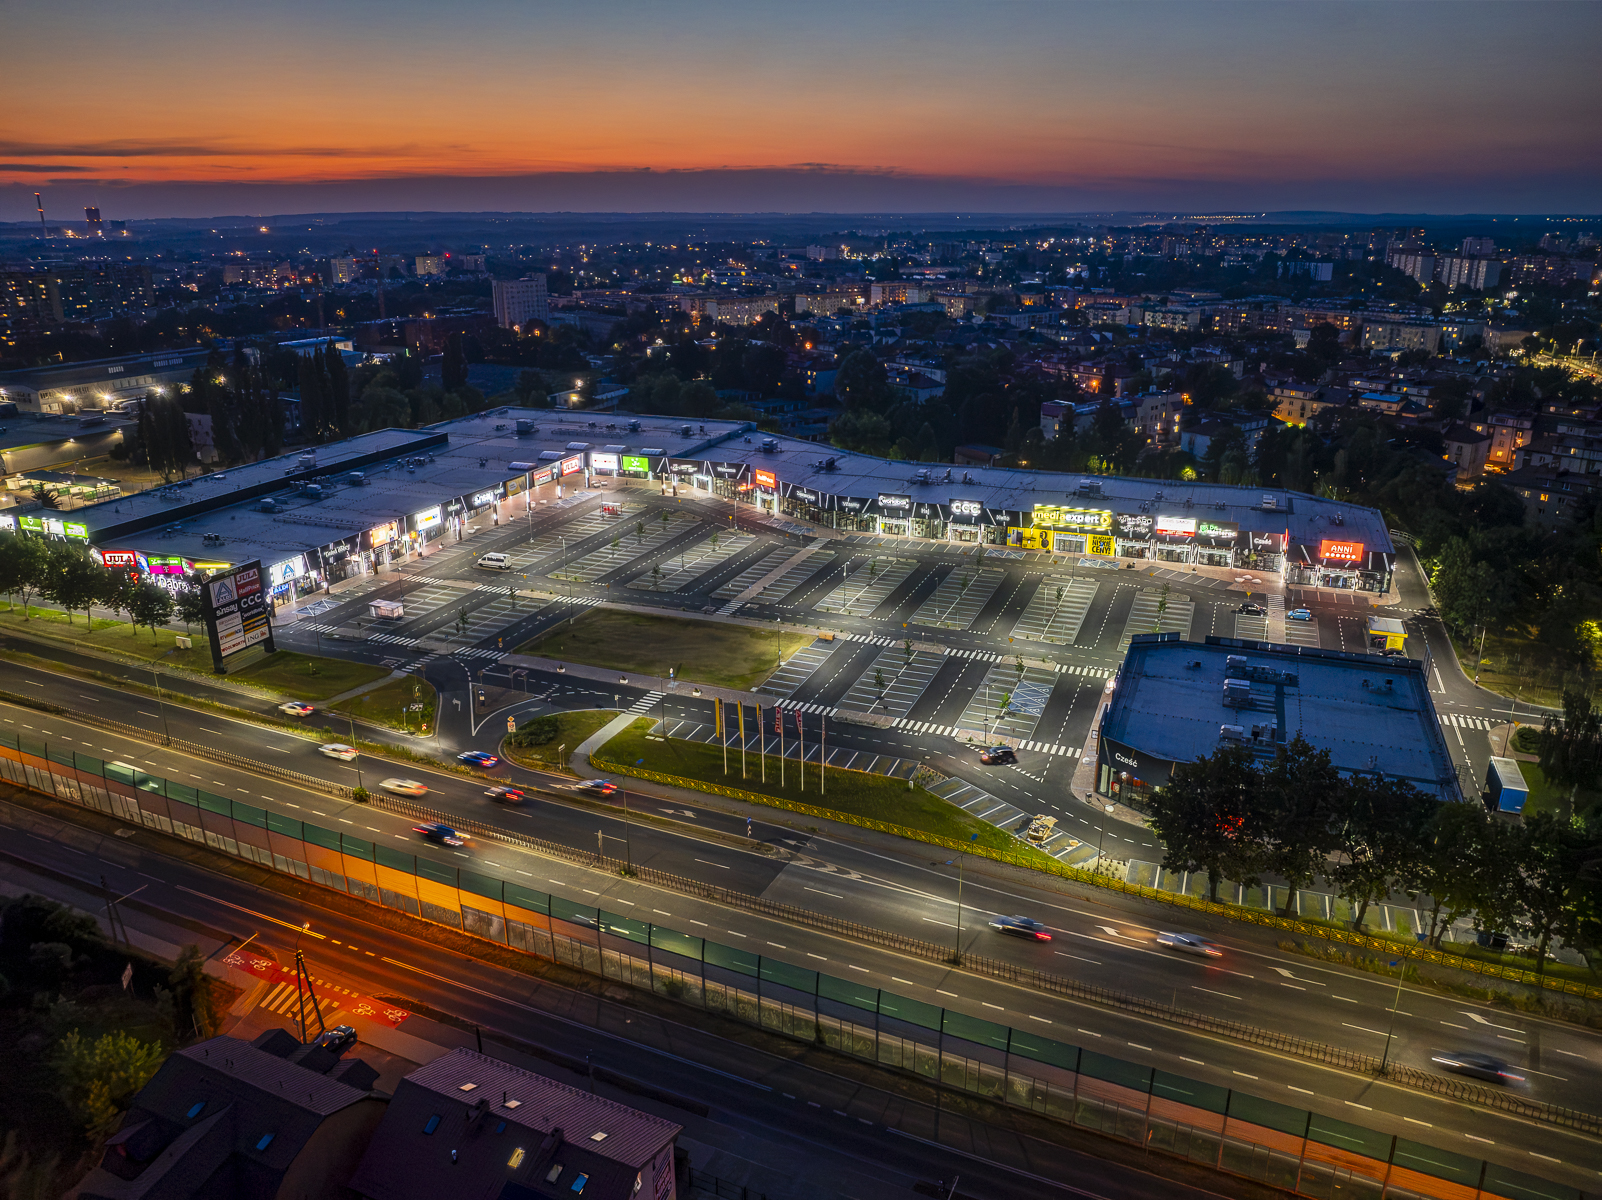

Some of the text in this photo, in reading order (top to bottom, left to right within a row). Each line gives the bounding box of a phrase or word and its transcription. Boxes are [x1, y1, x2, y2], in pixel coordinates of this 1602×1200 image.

[564, 461, 578, 472] JULA
[951, 501, 981, 516] CCC
[106, 555, 134, 563] JULA
[238, 570, 258, 583] JULA
[273, 583, 289, 594] ALDI
[218, 594, 232, 604] ALDI
[241, 593, 262, 608] CCC
[216, 603, 238, 617] sinsay
[247, 633, 260, 643] ING
[221, 639, 246, 652] WOOLWORTH
[1115, 752, 1138, 768] Cześć
